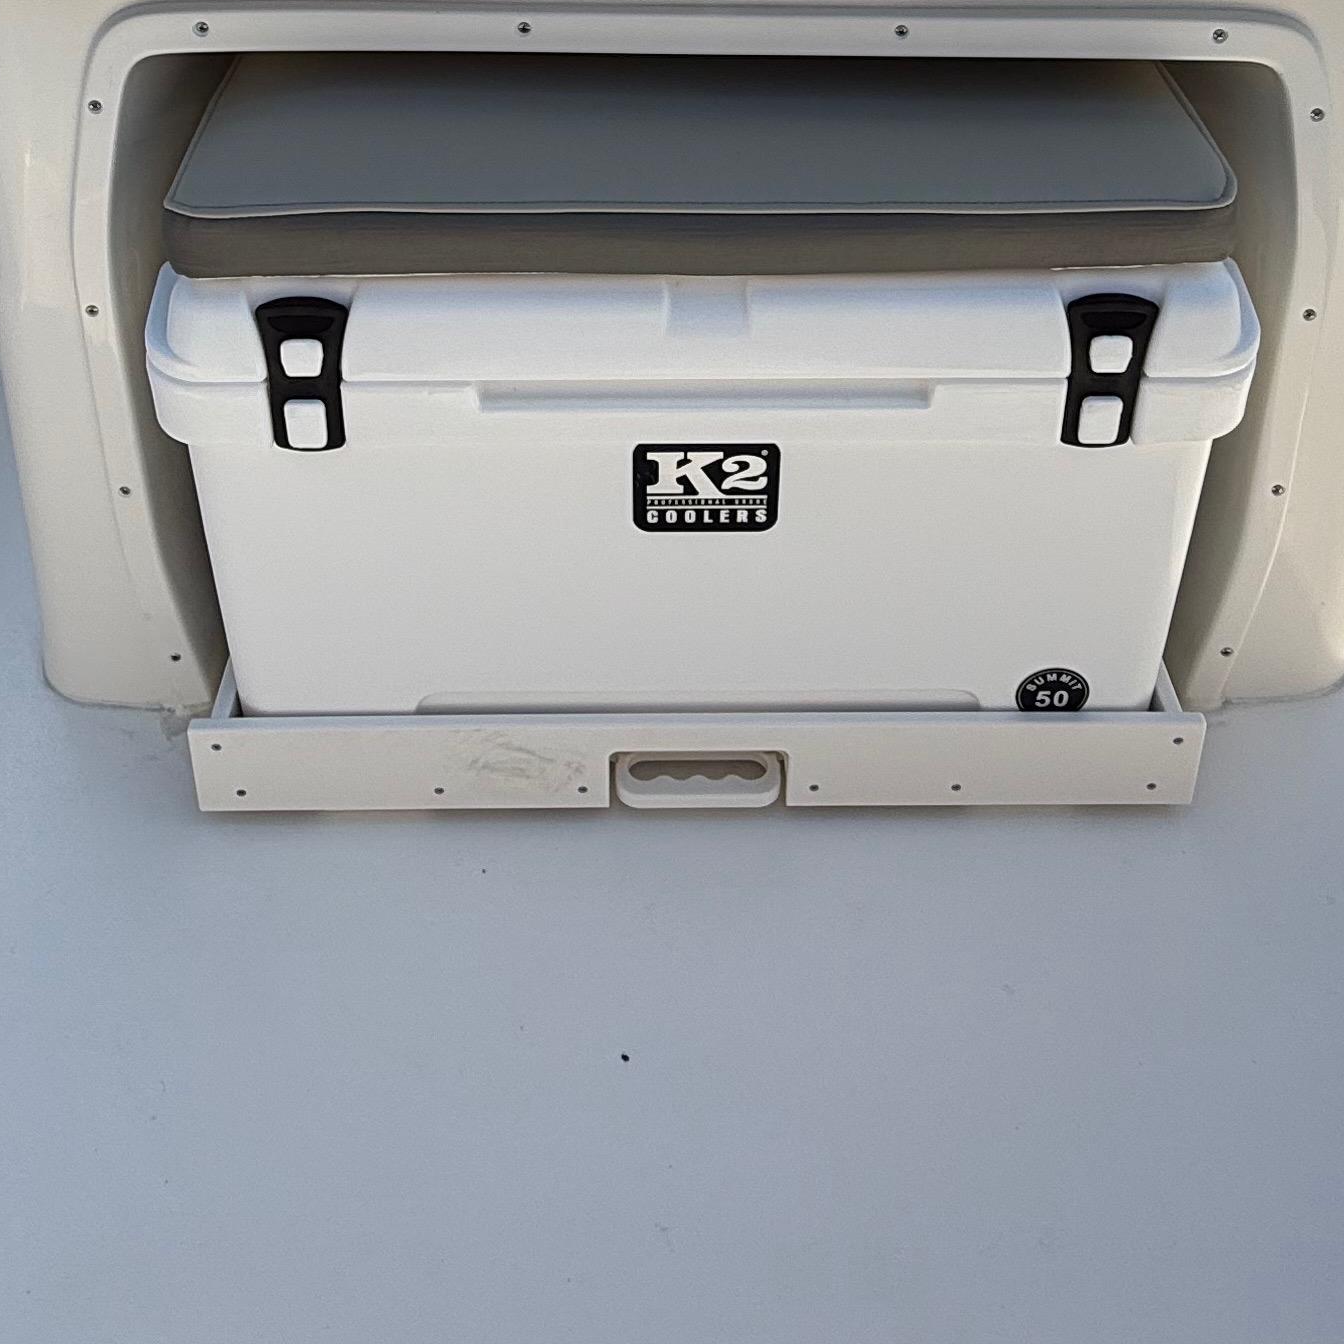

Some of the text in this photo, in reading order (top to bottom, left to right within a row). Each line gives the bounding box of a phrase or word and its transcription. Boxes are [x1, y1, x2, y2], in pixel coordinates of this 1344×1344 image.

[646, 451, 768, 496] K2
[646, 510, 768, 523] COOLERS
[1026, 673, 1083, 692] SUMMIT
[1035, 690, 1069, 707] 50
